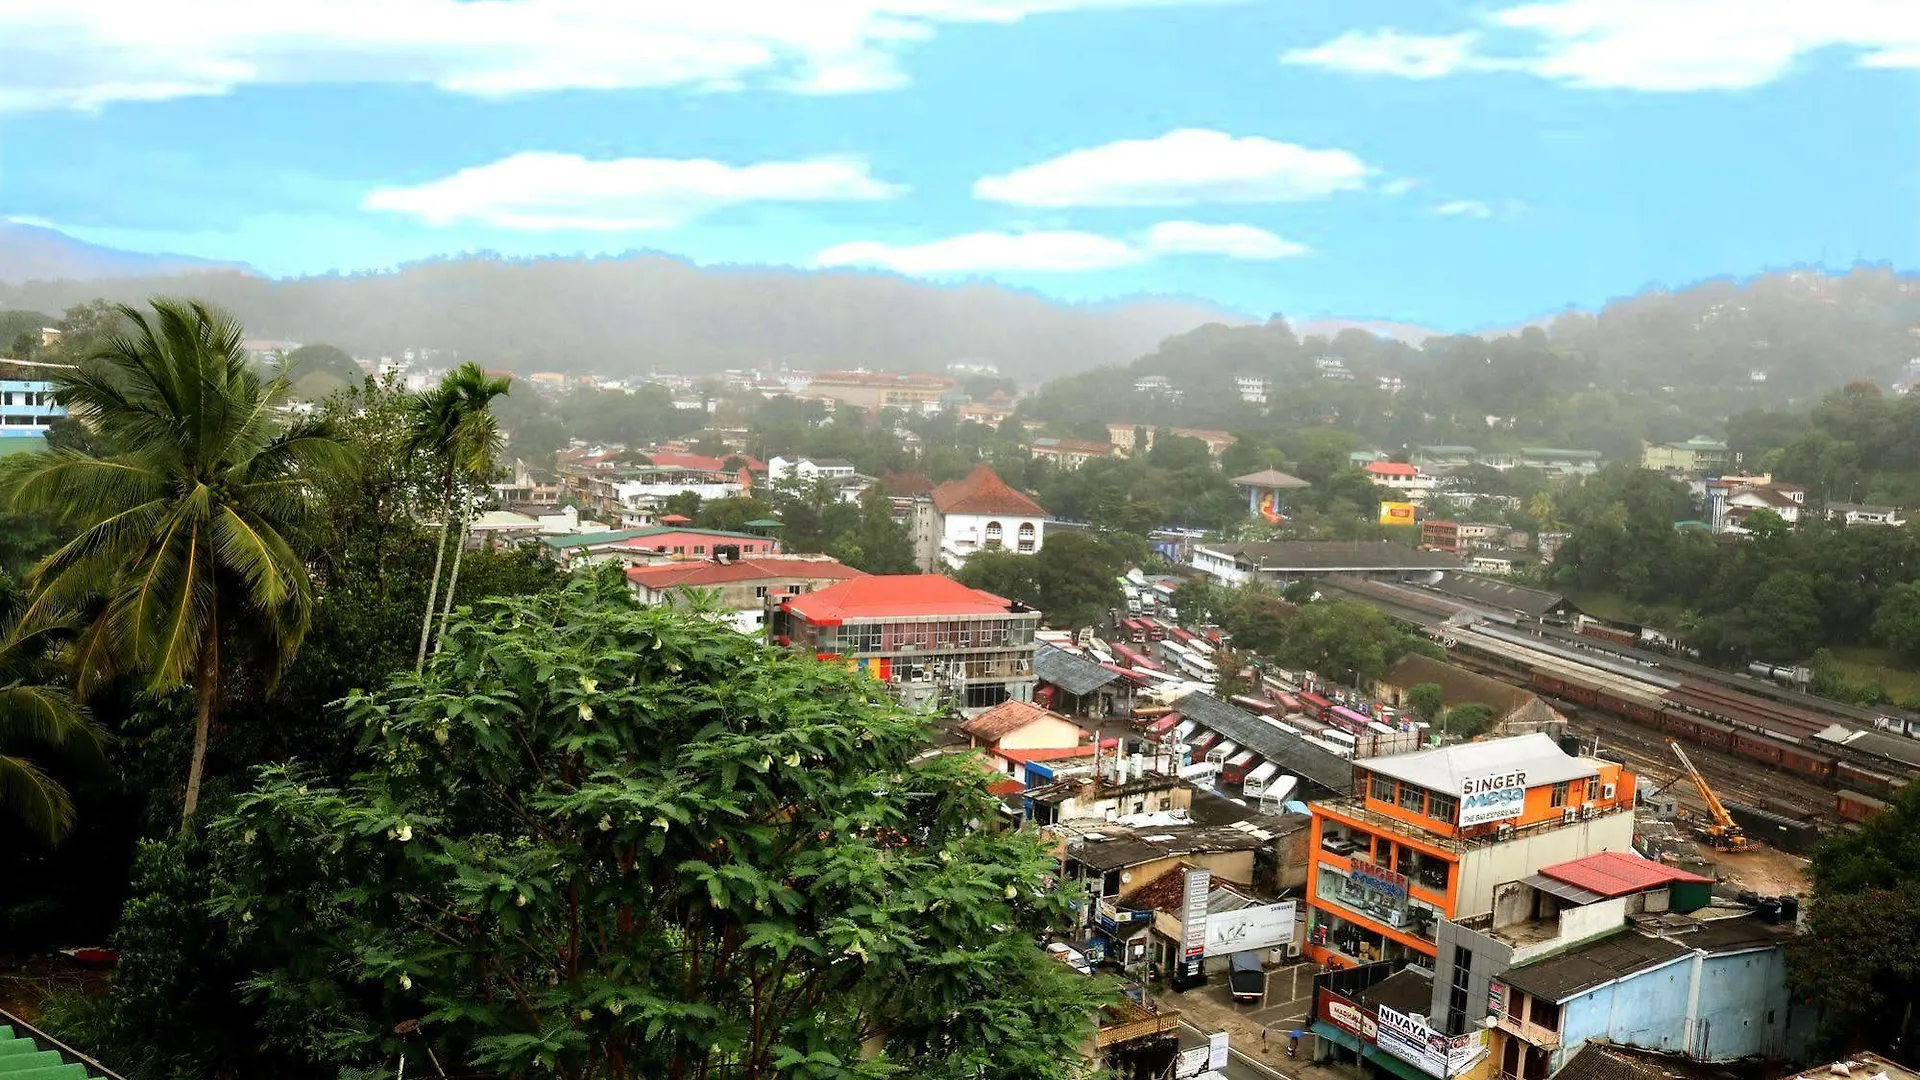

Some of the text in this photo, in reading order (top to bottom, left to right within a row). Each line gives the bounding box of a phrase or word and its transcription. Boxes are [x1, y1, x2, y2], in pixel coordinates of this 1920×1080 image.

[1464, 773, 1526, 794] SINGER
[1351, 858, 1405, 888] SINGER
[1380, 1018, 1426, 1043] INTERNATIONAL
[1381, 1008, 1427, 1039] NIVAYA
